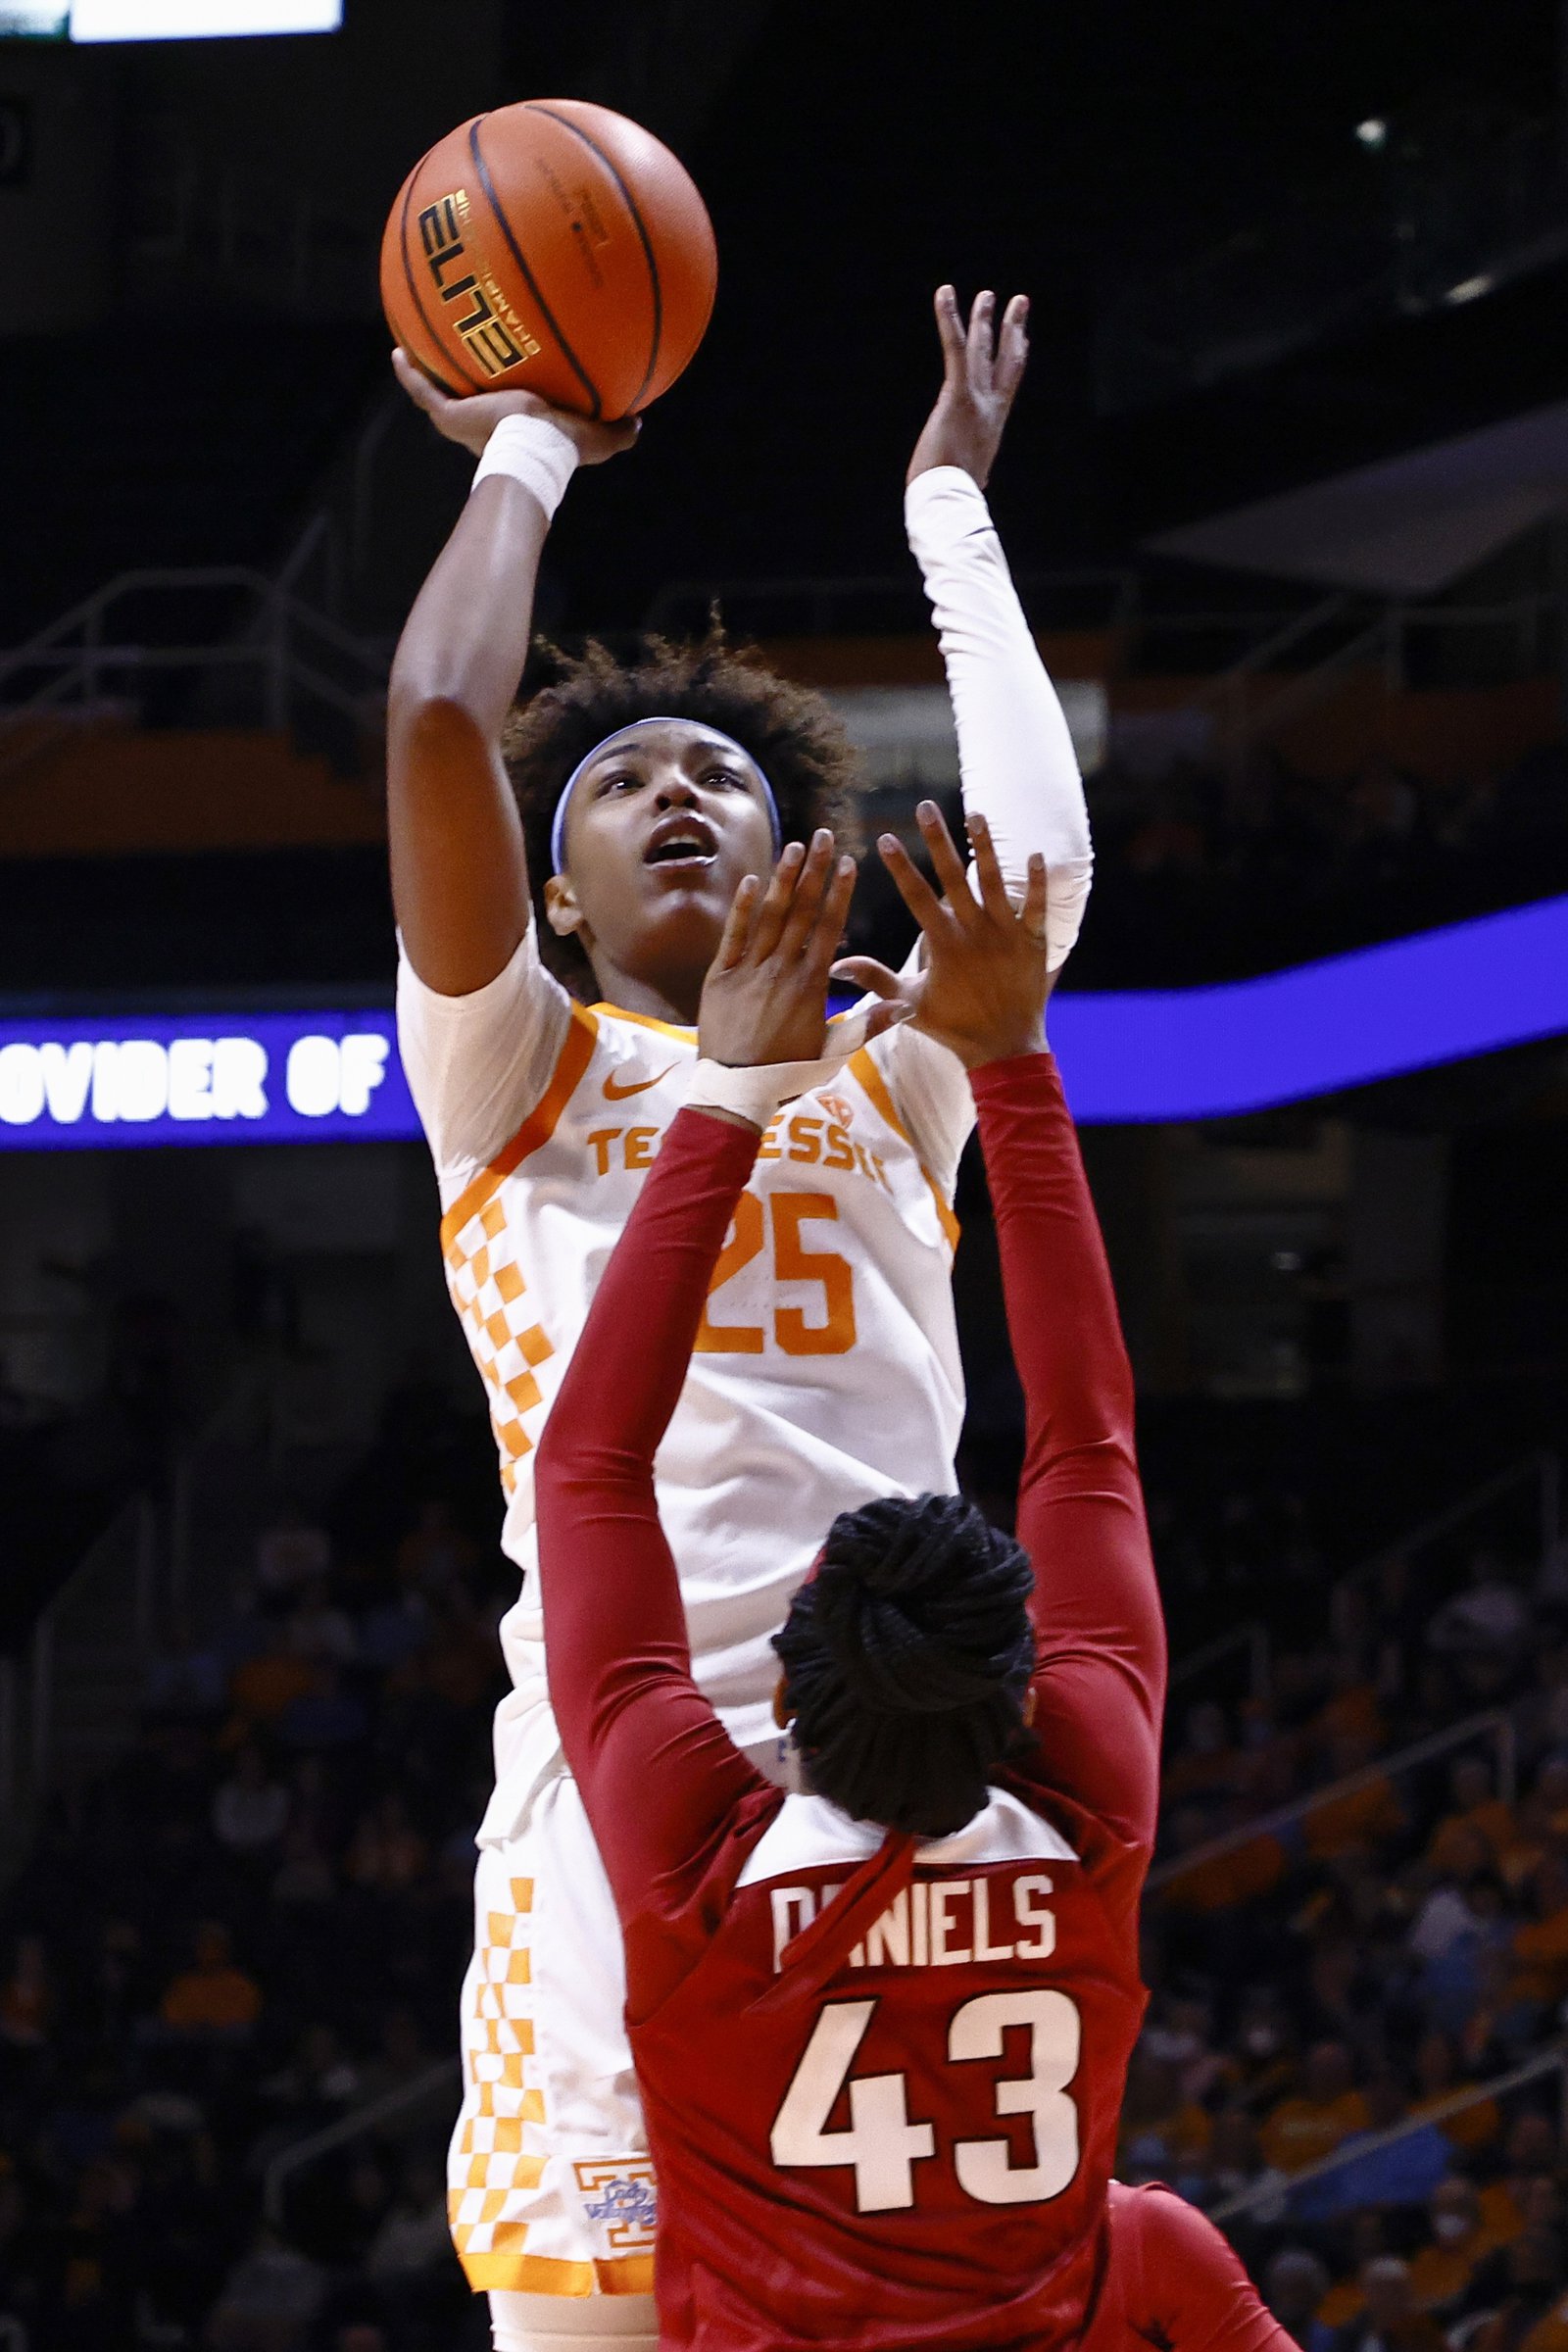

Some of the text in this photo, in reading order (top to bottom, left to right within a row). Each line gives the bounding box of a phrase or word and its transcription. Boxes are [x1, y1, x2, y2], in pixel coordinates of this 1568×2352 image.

[417, 193, 530, 379] ELITE
[286, 1034, 389, 1117] OF
[692, 1191, 856, 1356] 25
[770, 1989, 1080, 2213] 43
